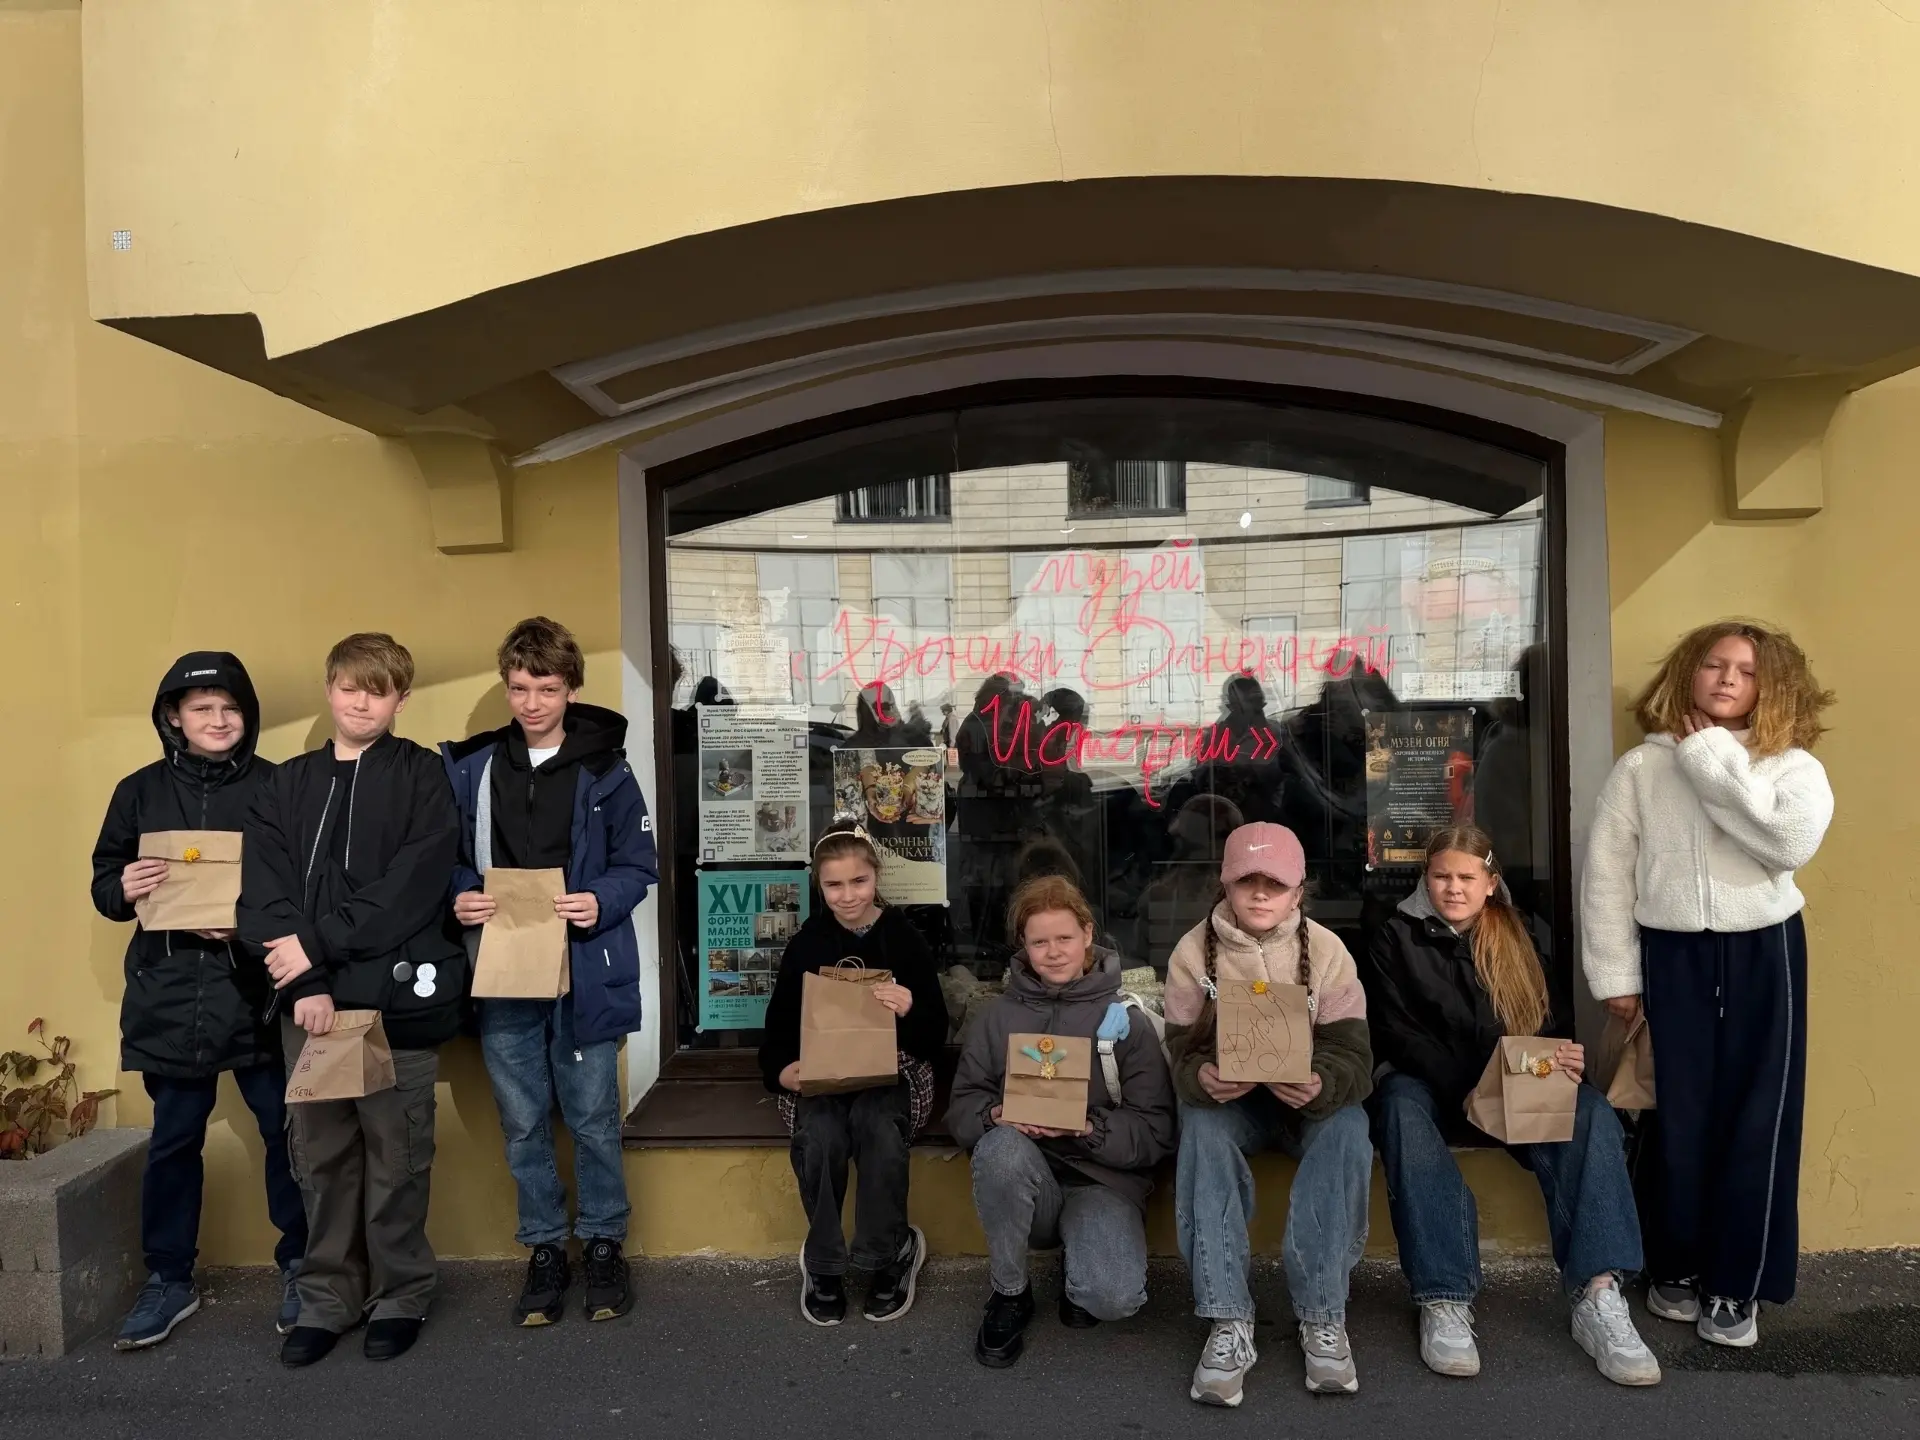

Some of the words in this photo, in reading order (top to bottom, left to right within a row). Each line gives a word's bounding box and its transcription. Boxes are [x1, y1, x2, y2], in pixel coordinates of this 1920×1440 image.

[1032, 538, 1201, 636] музей
[1079, 613, 1397, 691] Огненной
[1390, 736, 1422, 748] МУЗЕЙ
[1425, 736, 1450, 748] ОГНЯ
[708, 884, 762, 913] XVI
[708, 916, 749, 925] ФОРУМ
[708, 927, 750, 936] МАЛЫХ
[708, 937, 751, 946] МУЗЕЕВ
